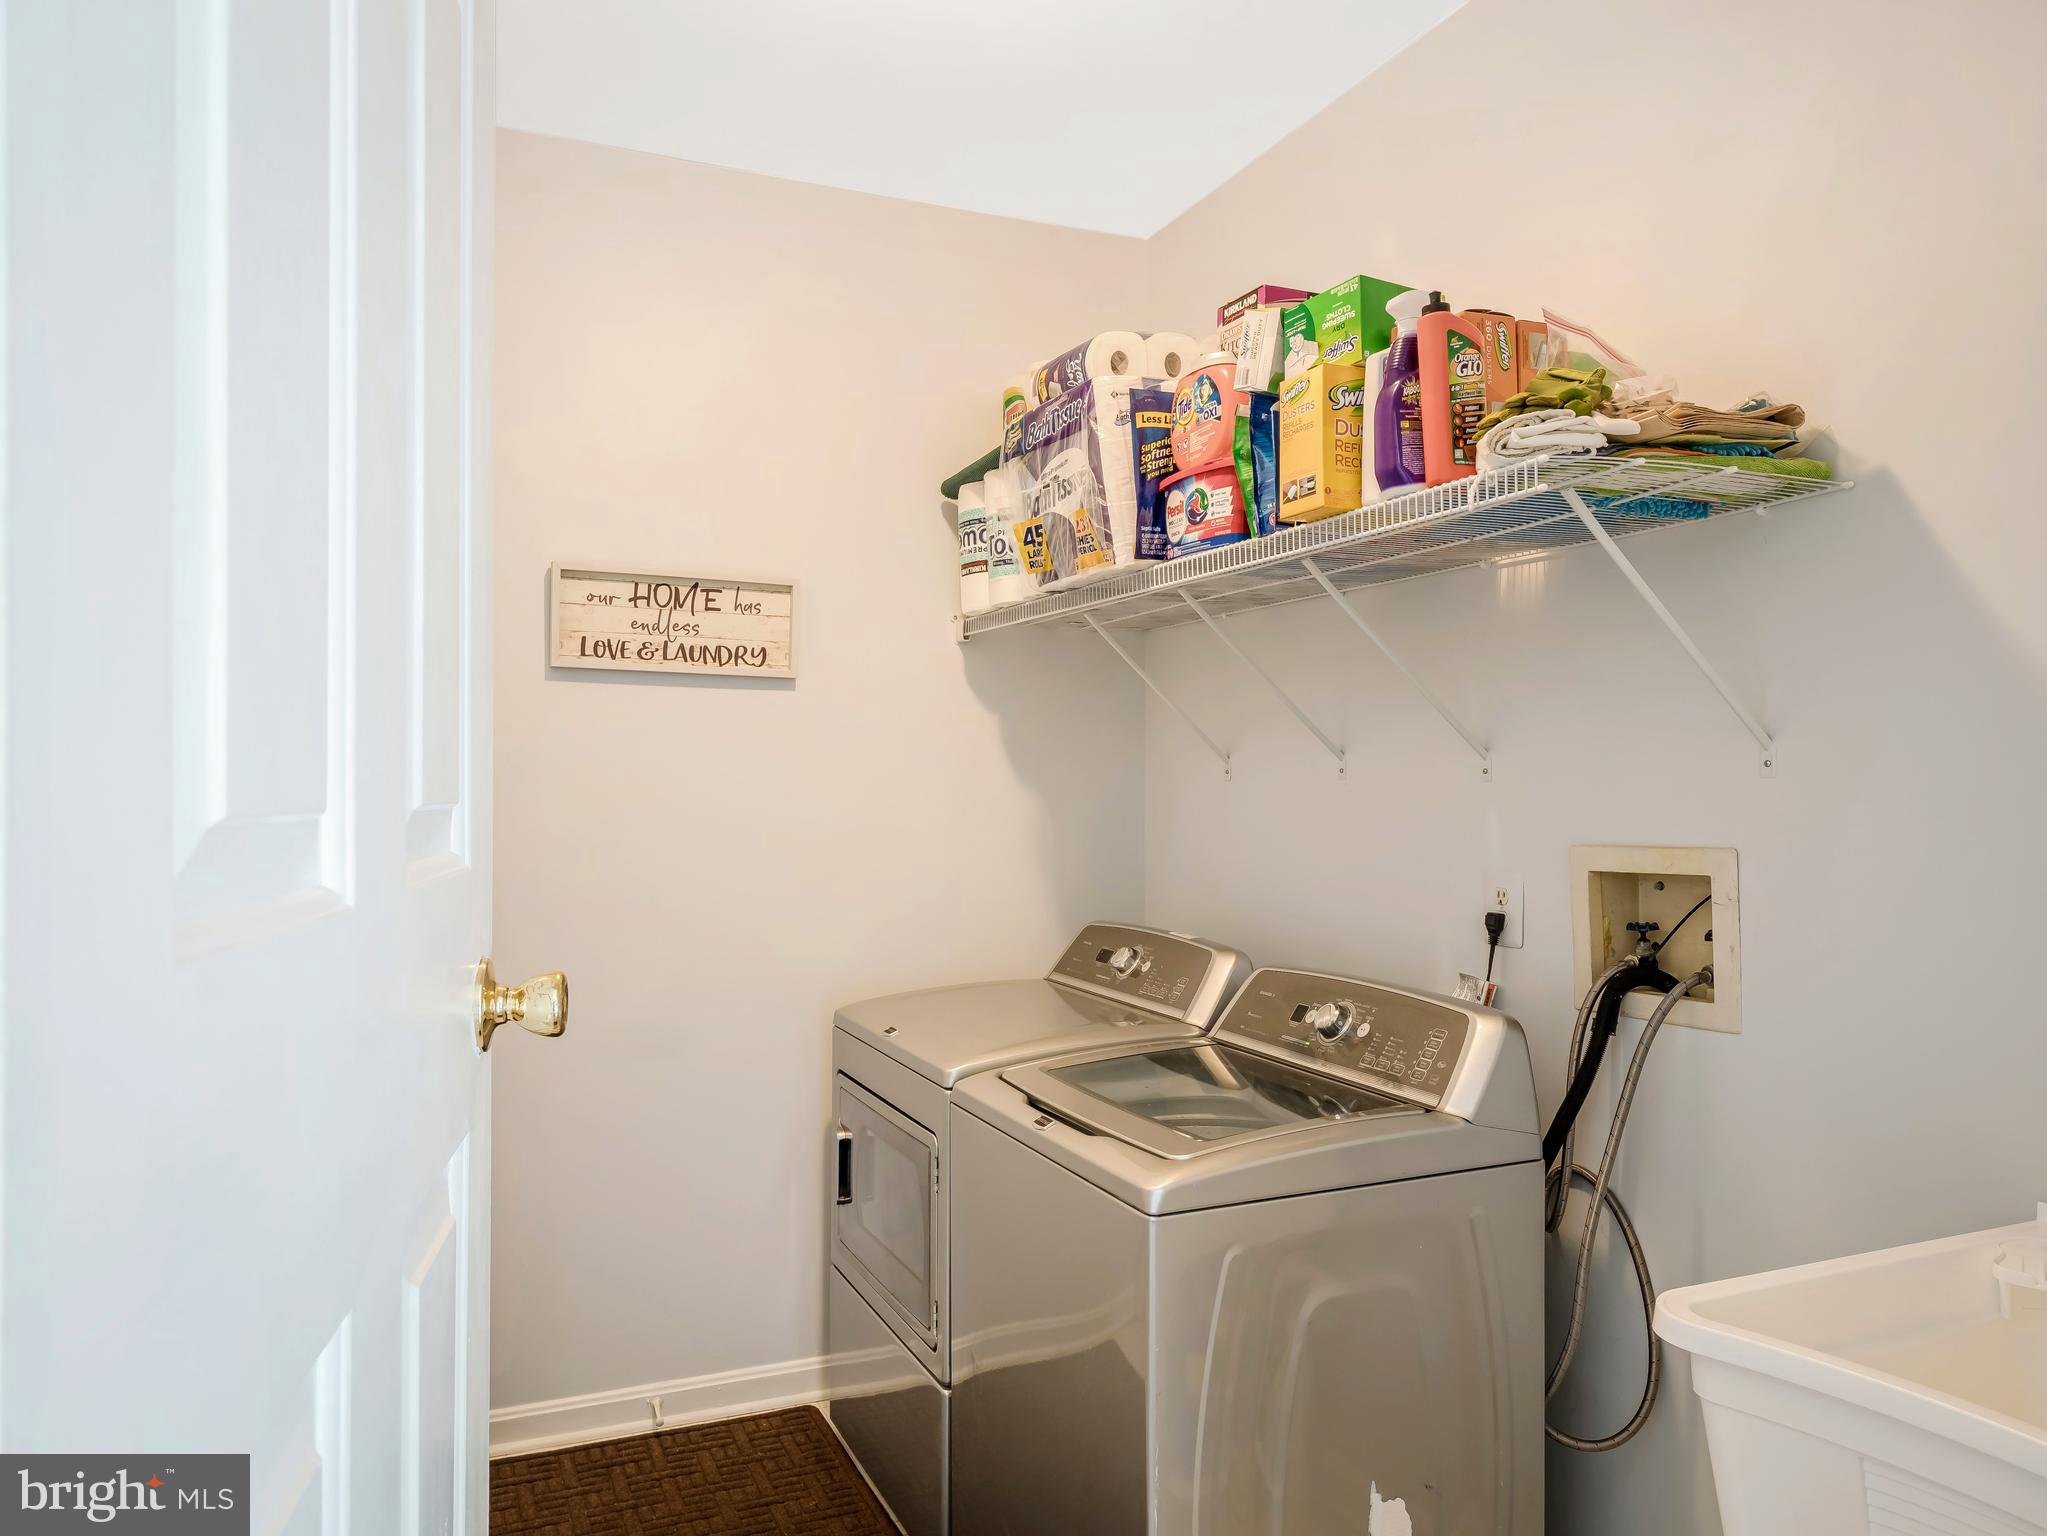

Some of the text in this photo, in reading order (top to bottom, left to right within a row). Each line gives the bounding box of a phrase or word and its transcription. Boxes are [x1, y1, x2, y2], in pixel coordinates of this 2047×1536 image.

[1223, 293, 1258, 319] KIRKLAND
[1321, 310, 1356, 330] SWEEPING
[1323, 335, 1358, 359] Swiffer
[1494, 322, 1510, 370] Swiffer
[1454, 352, 1480, 363] Orange
[1456, 361, 1483, 377] GLO
[1281, 378, 1310, 406] Swiffer
[1332, 384, 1364, 411] Swi
[1178, 396, 1192, 416] Tide
[1203, 406, 1218, 420] OXI
[1282, 401, 1315, 422] DUSTERS
[1141, 414, 1172, 424] Less Li
[1141, 436, 1172, 453] Superio
[1141, 447, 1173, 464] Softne
[1167, 500, 1185, 520] Persil
[1023, 523, 1044, 548] 45
[586, 581, 762, 616] our HOME has
[630, 606, 701, 643] endless
[580, 635, 768, 668] LOVE & LAUNDRY
